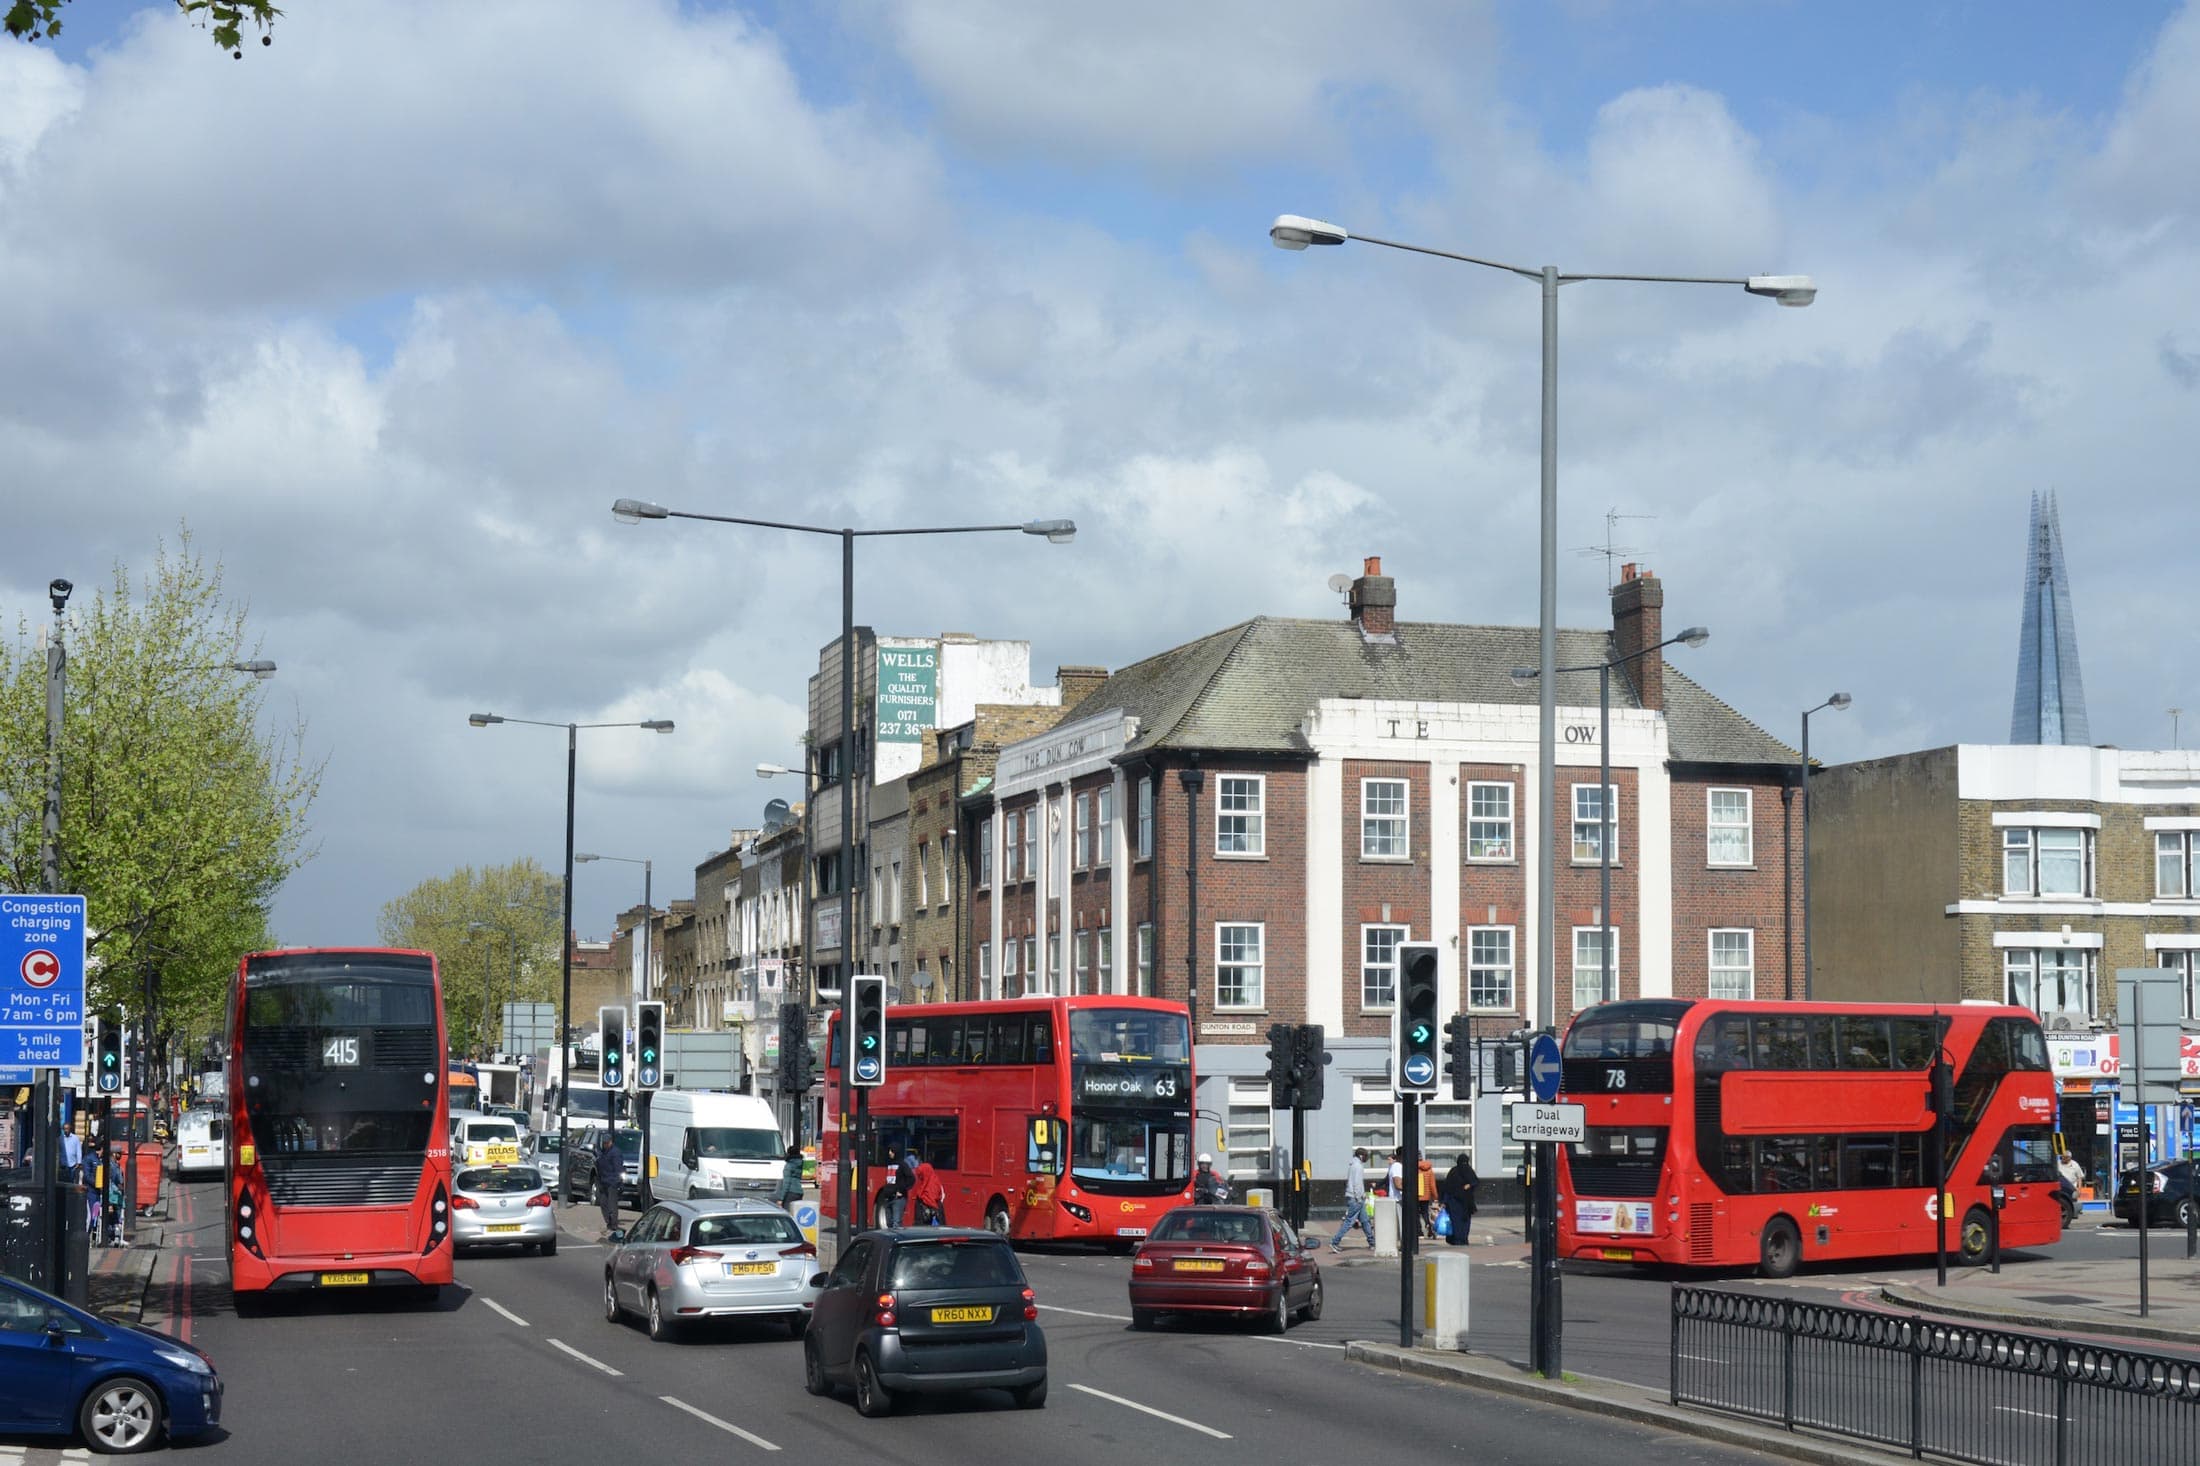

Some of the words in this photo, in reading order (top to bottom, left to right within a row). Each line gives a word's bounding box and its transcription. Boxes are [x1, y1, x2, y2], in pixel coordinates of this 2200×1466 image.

[882, 653, 934, 668] WELLS
[897, 672, 917, 682] THE
[887, 683, 927, 694] QUALITY
[879, 694, 934, 706] FURNISHERS
[897, 710, 917, 721] 0171
[879, 722, 901, 735] 237
[1025, 752, 1040, 771] THE
[2, 900, 81, 916] Congestion
[11, 916, 71, 930] charging
[24, 932, 57, 943] zone
[10, 993, 40, 1006] Mon
[52, 993, 70, 1006] Fri
[32, 1033, 61, 1046] mile
[18, 1048, 60, 1060] ahead
[324, 1039, 357, 1064] 415
[1606, 1069, 1626, 1089] 78
[1085, 1080, 1118, 1092] Honor
[1120, 1080, 1142, 1093] Oak
[1155, 1080, 1176, 1097] 63
[1536, 1109, 1560, 1121] Dual
[1516, 1124, 1580, 1137] carriageway
[427, 1149, 447, 1158] 2518
[487, 1146, 516, 1156] ATLAS
[937, 1309, 965, 1321] YR60
[968, 1308, 988, 1319] NXX
